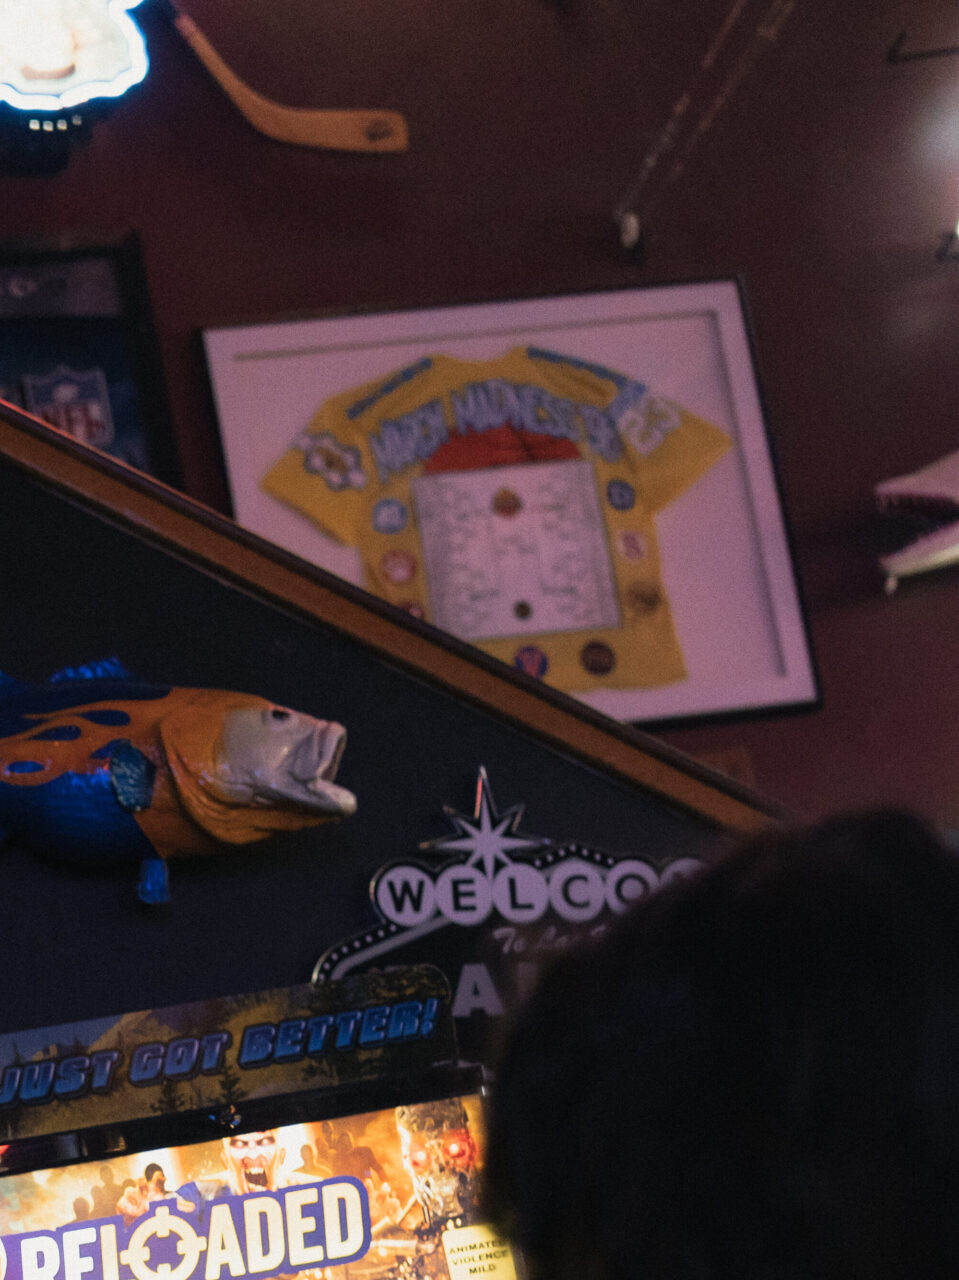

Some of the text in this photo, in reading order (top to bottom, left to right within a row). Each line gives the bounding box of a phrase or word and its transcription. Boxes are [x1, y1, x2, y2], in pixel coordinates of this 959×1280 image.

[386, 868, 685, 914] WELCO
[129, 1032, 229, 1083] GOT
[239, 997, 439, 1064] BETTER!
[452, 1249, 509, 1265] VIOLENCE
[469, 1263, 496, 1274] MILD
